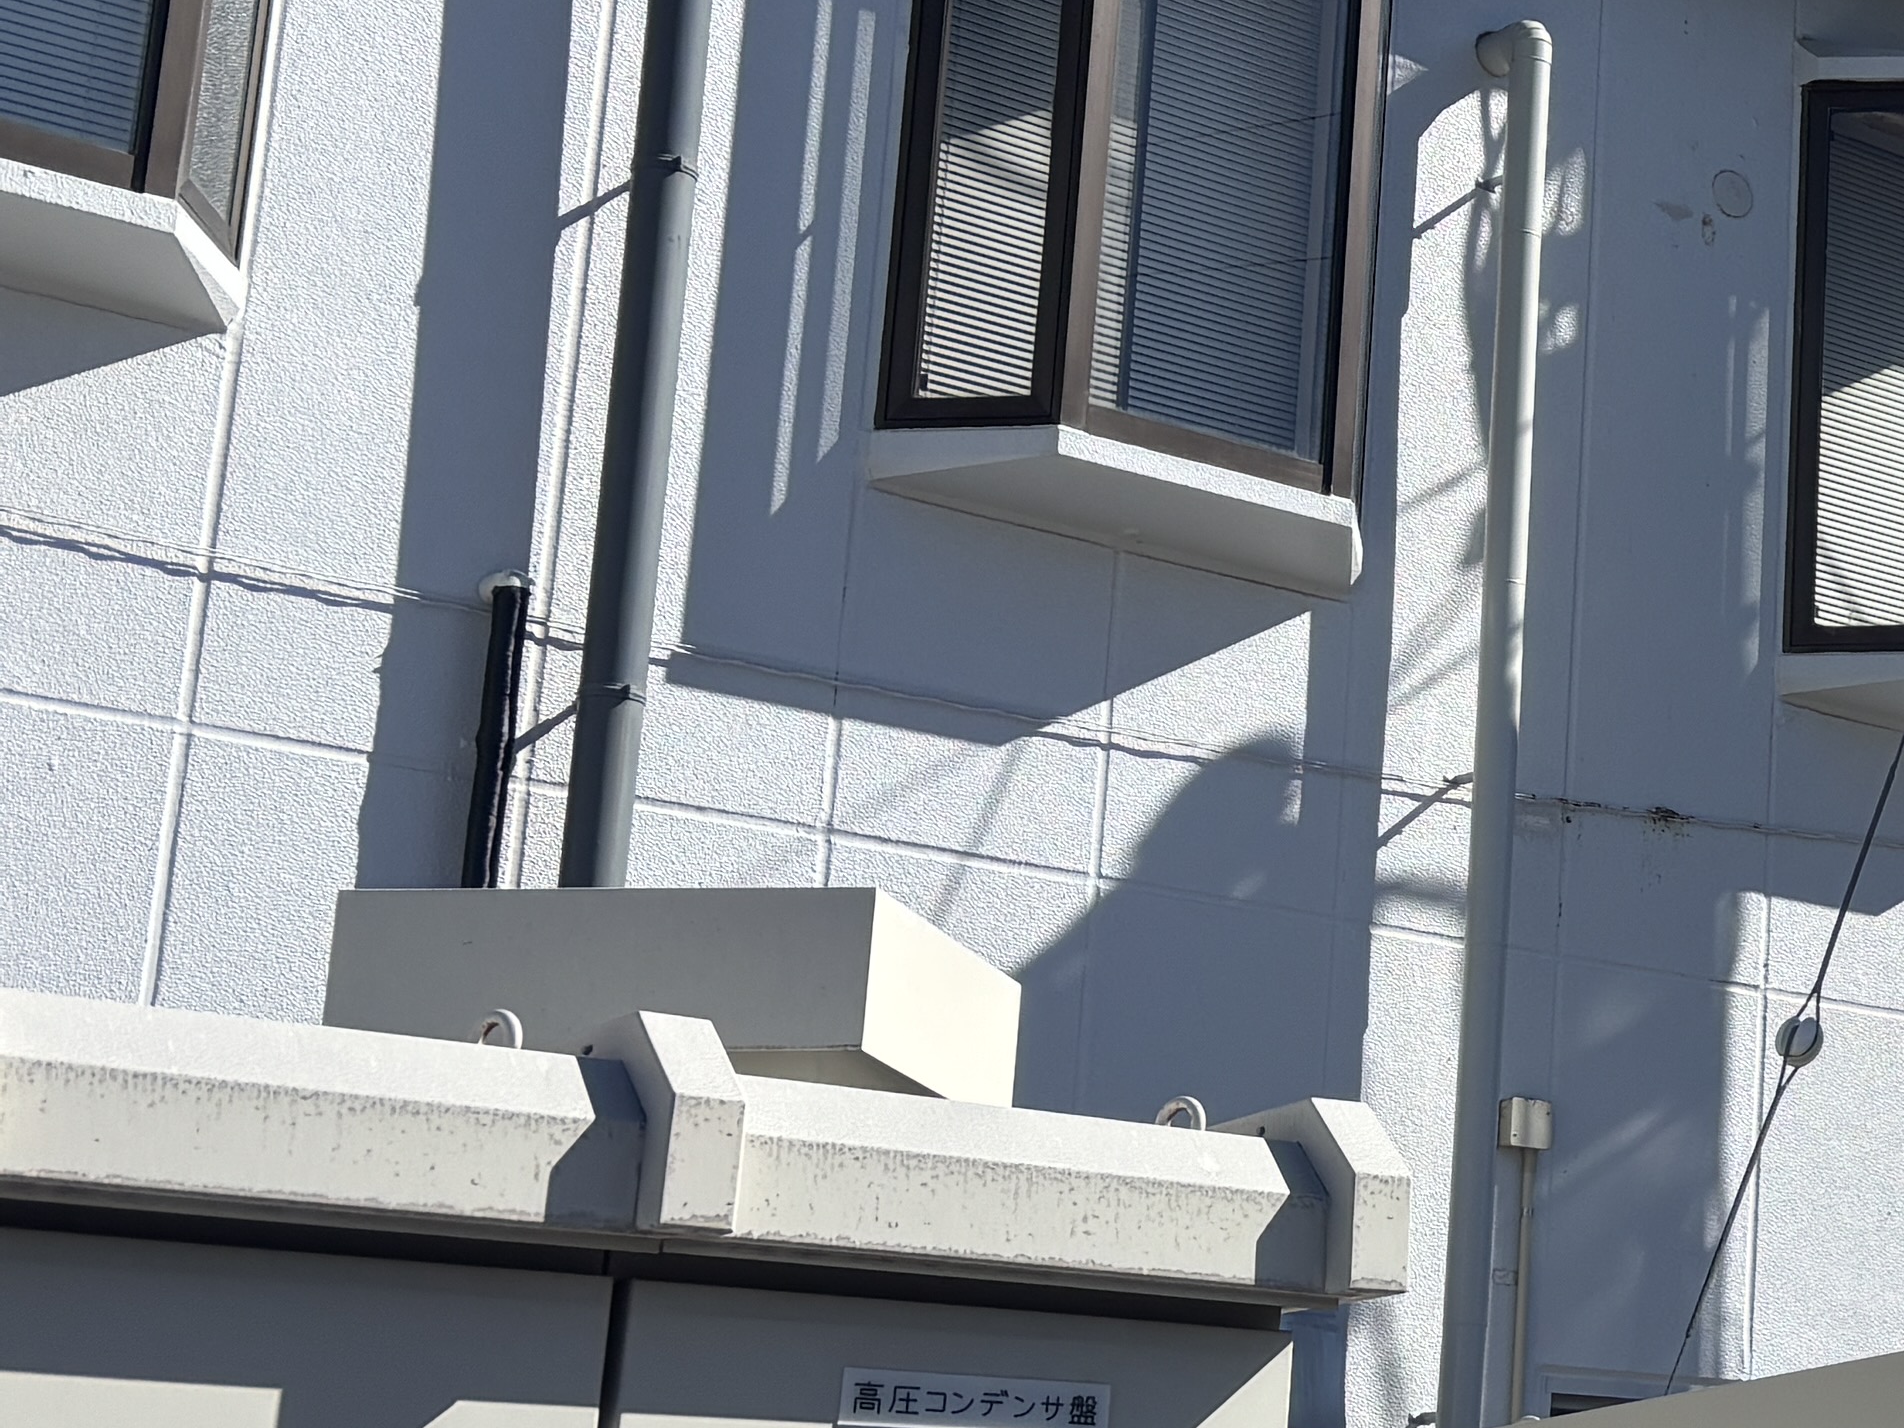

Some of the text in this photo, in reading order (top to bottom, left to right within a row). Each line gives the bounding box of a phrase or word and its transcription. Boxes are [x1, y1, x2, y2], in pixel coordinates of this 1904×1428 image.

[852, 1380, 1098, 1427] 高圧コンデンサ盤
